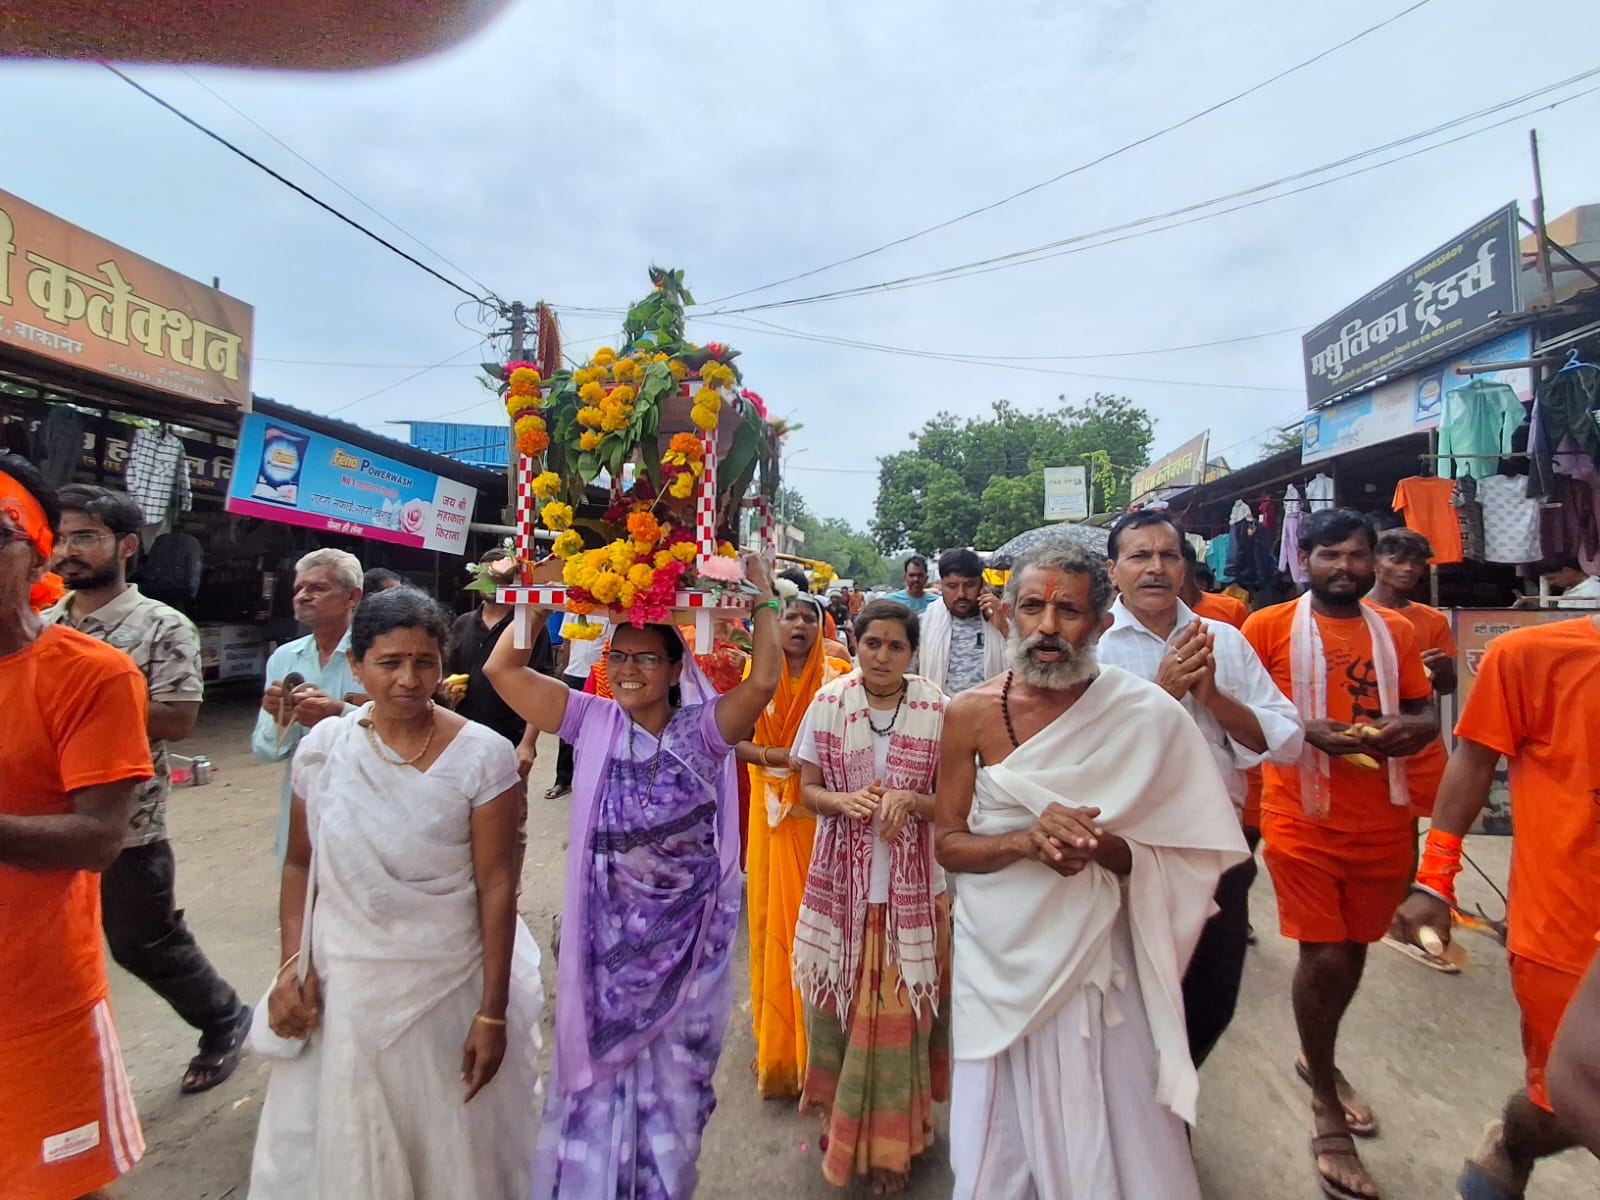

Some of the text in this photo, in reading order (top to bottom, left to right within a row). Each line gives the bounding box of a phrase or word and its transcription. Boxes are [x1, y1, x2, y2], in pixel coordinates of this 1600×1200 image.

[1413, 237, 1497, 335] ट्रेडर्स
[25, 250, 242, 380] कलेक्शन
[332, 448, 413, 487] Fena POWERWASH
[442, 495, 456, 508] जय
[436, 509, 465, 525] महाकाल
[435, 523, 460, 541] किराना
